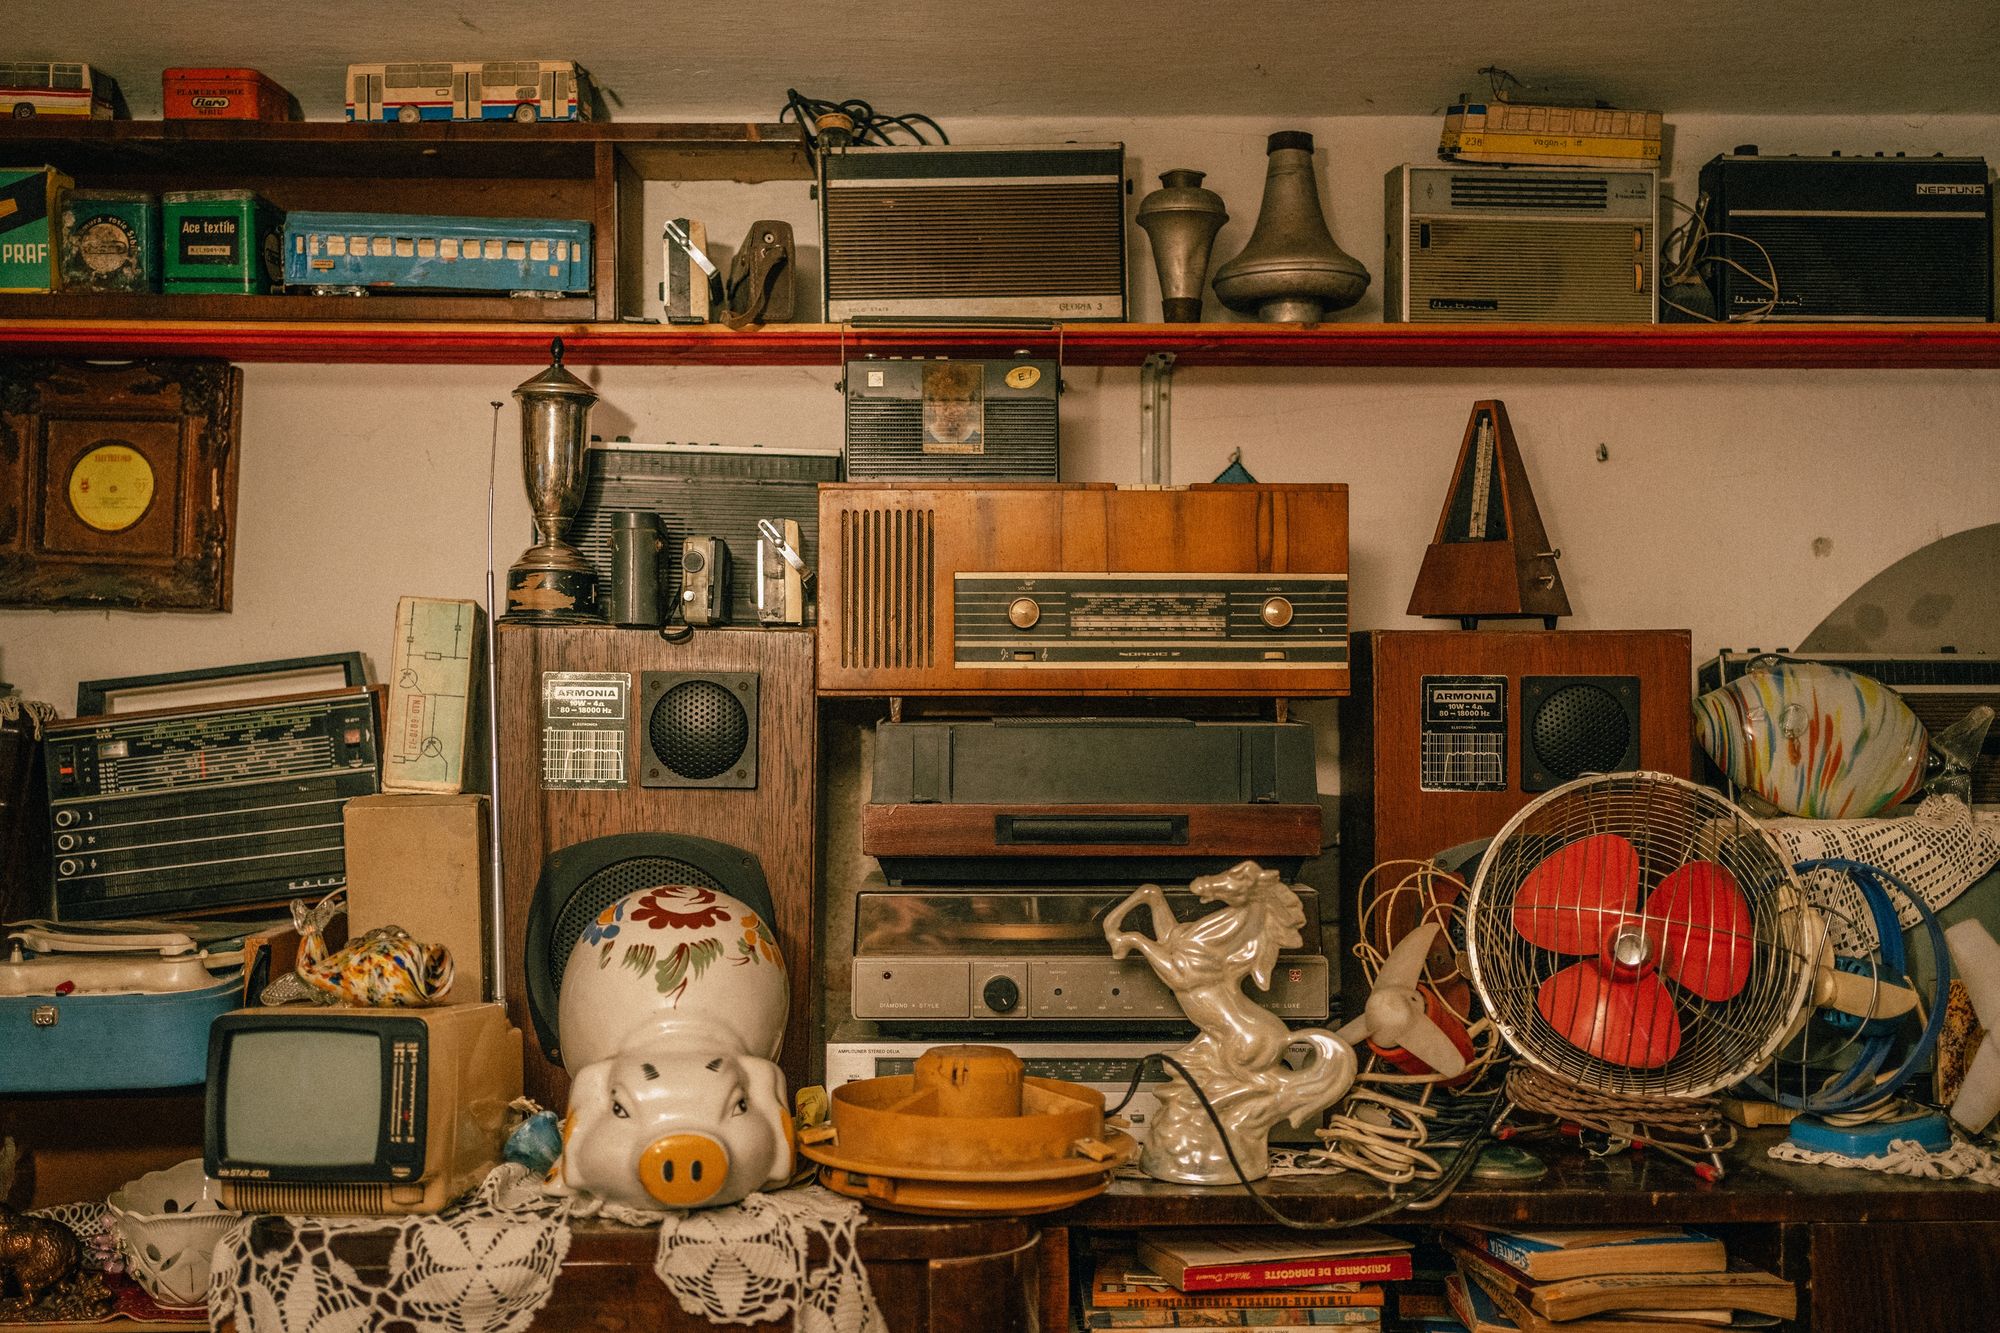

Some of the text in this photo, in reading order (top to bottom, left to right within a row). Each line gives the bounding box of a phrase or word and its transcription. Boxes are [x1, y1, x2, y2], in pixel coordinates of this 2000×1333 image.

[182, 220, 235, 233] Ace textile
[1058, 302, 1103, 311] GLORIA 3
[557, 689, 616, 698] ARMONIA
[1436, 692, 1494, 700] ARMONIA
[1264, 1267, 1317, 1280] DRAGOSTE
[1318, 1266, 1332, 1277] DE
[1334, 1263, 1392, 1276] SCRISOAREA
[1344, 1311, 1366, 1322] 1989
